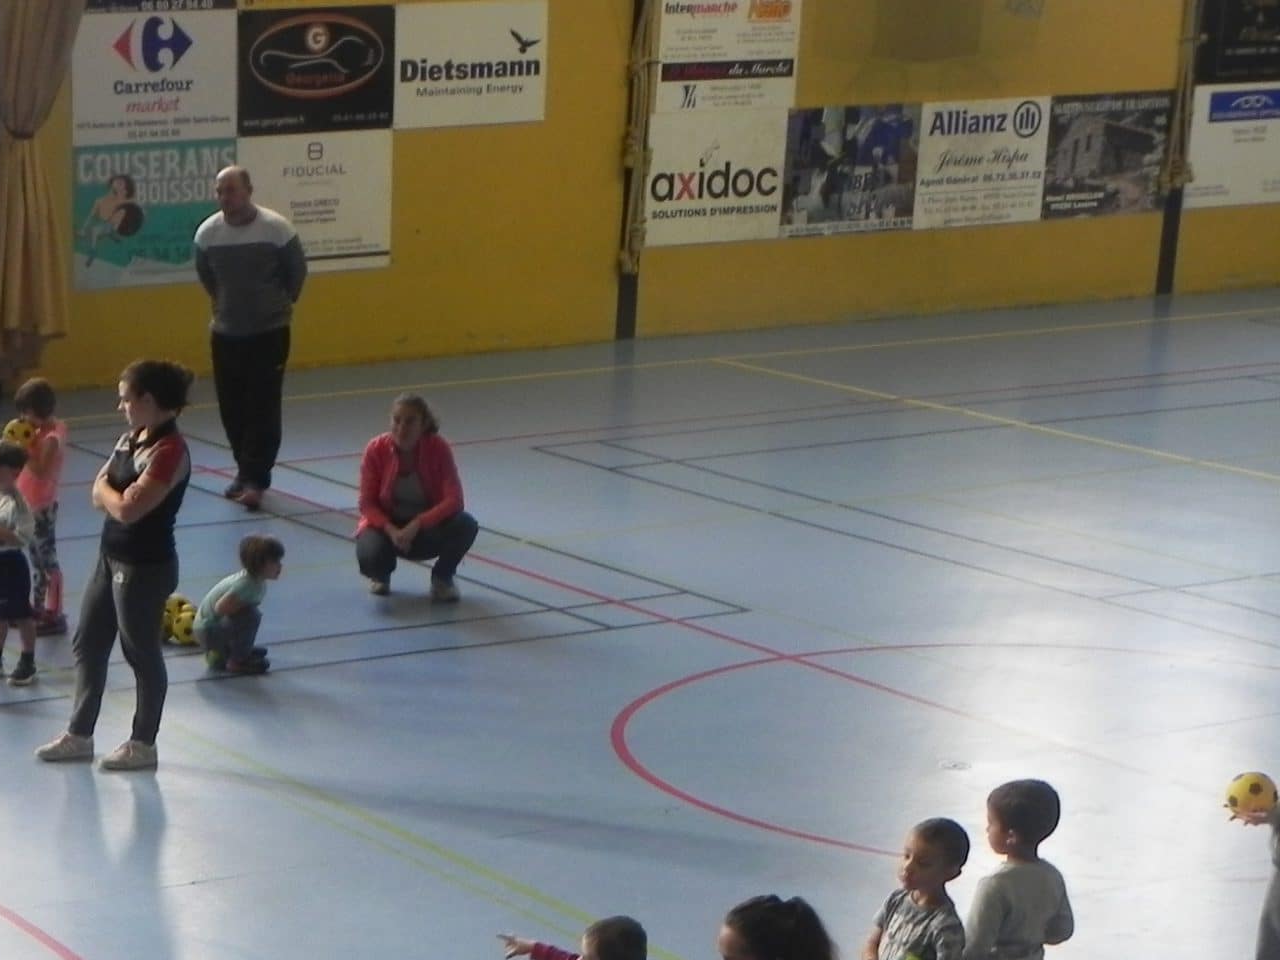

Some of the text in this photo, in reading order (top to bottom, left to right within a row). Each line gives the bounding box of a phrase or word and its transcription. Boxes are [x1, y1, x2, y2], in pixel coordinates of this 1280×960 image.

[399, 57, 541, 83] Dietsmann
[113, 77, 194, 95] Carrefour
[416, 83, 524, 97] Maintaining Energy
[125, 96, 181, 113] market
[929, 109, 1008, 136] Allianz
[78, 147, 235, 183] COUSERANS
[282, 164, 348, 177] FIDUCIAL
[650, 158, 778, 202] axidoc
[136, 178, 219, 205] BOISSON
[651, 204, 778, 219] SOLUTIONS D'IMPRESSION
